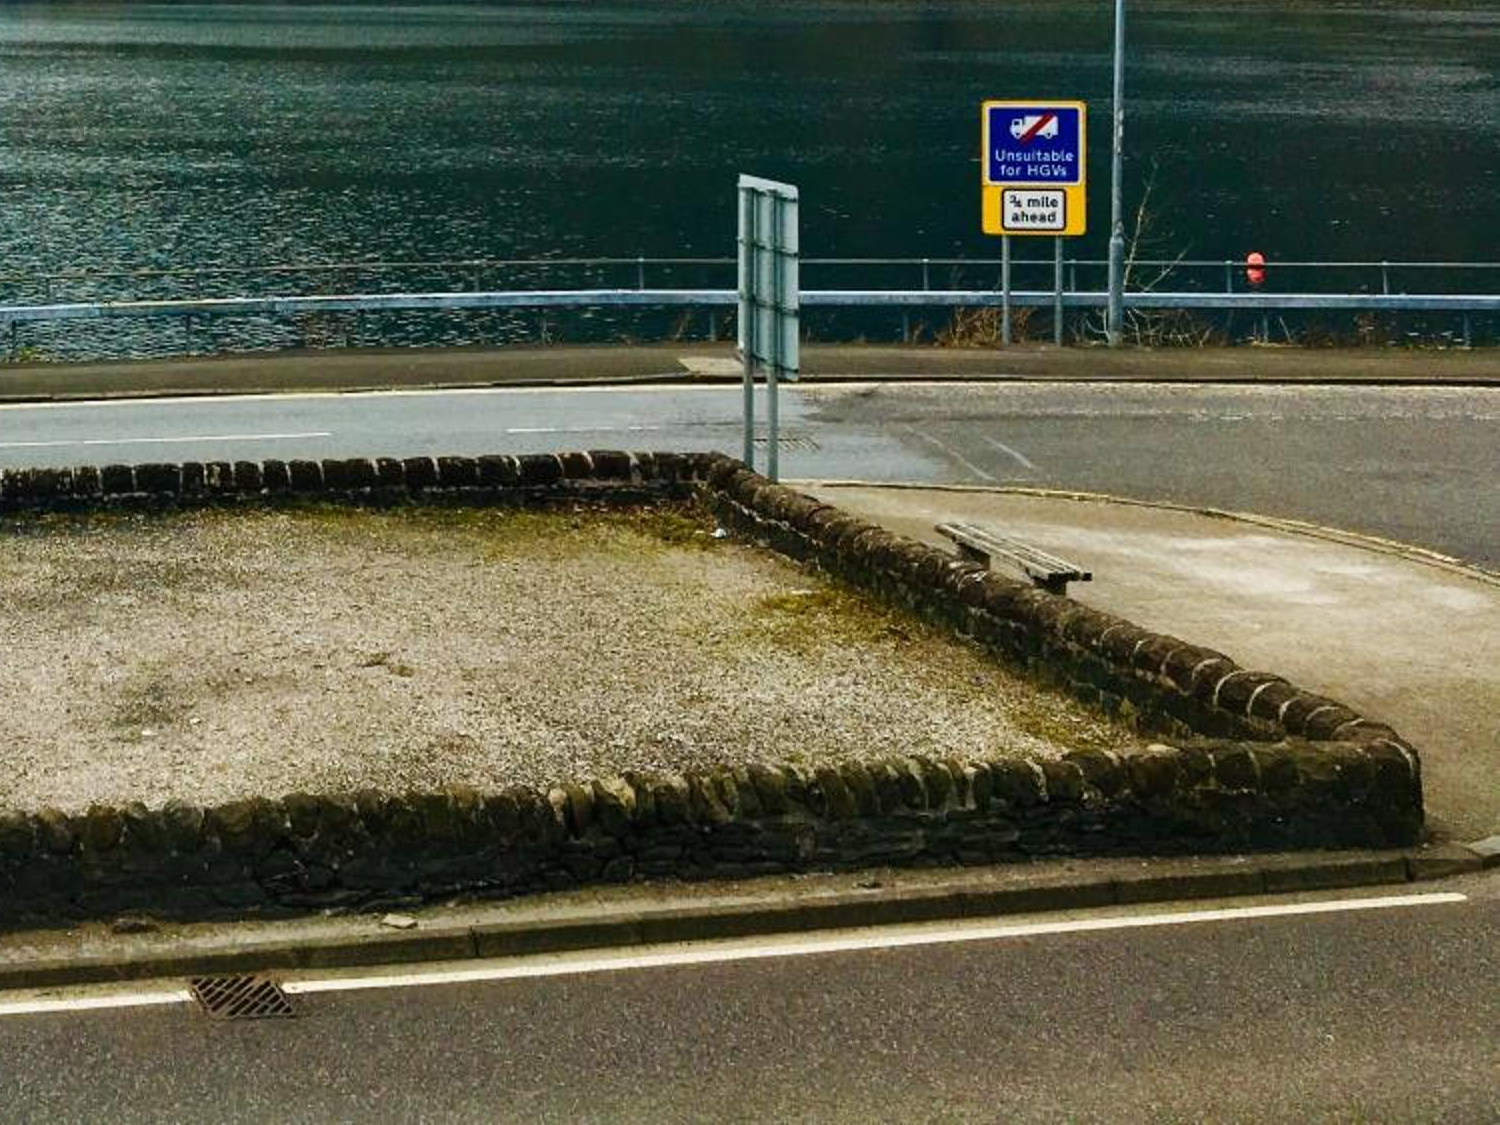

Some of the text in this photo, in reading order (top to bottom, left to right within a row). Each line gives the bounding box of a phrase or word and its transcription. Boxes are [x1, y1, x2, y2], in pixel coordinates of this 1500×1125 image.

[995, 149, 1074, 162] Unsuitable
[1000, 164, 1067, 177] for HGVs
[1027, 196, 1059, 208] mile
[1011, 211, 1057, 223] ahead
